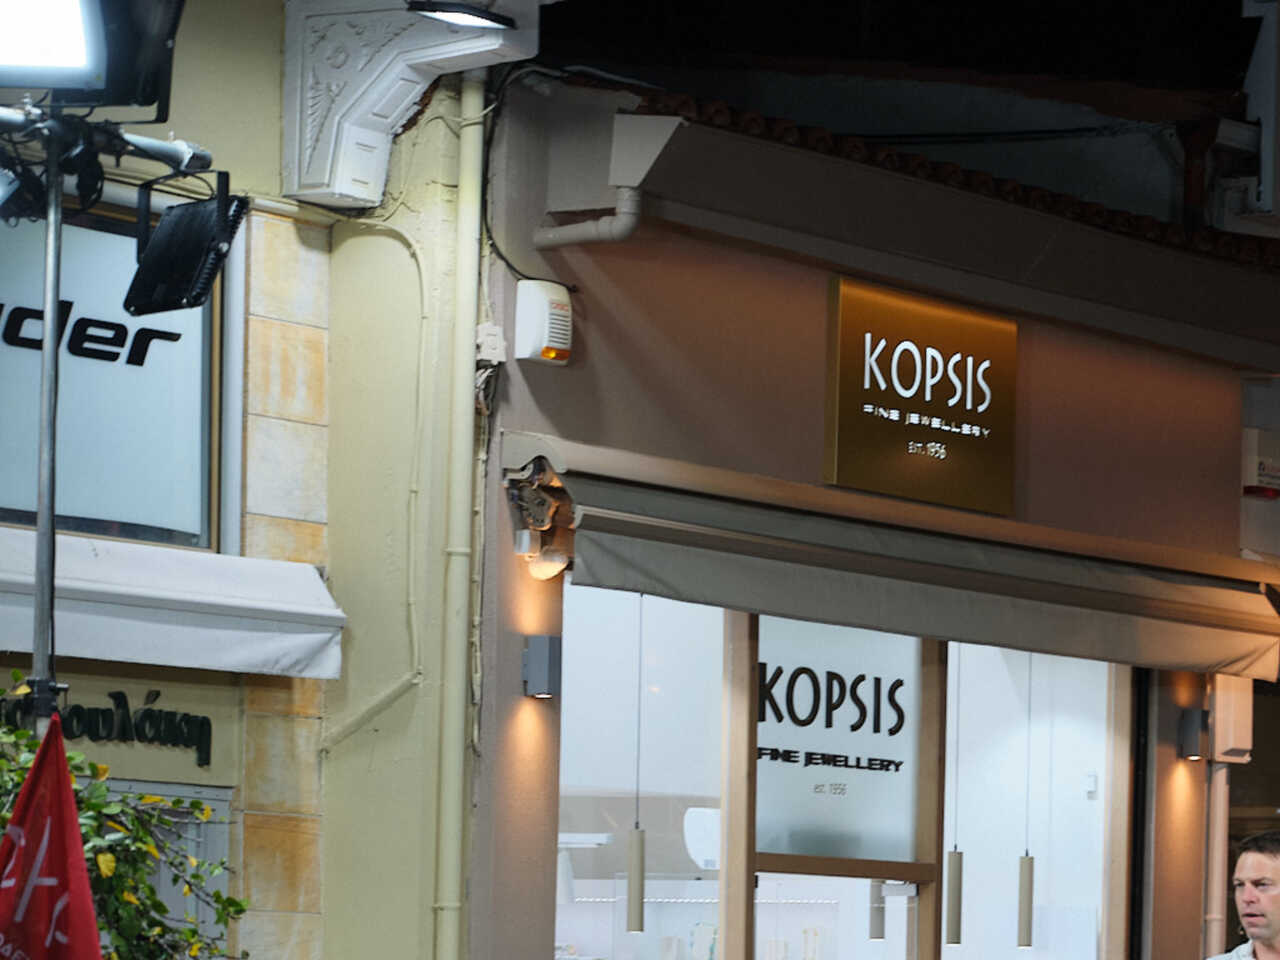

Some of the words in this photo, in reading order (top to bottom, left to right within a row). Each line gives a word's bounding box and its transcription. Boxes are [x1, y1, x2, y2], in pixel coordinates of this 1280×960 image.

[0, 300, 182, 367] der
[863, 332, 992, 414] KOPSIS
[863, 404, 900, 421] FINE
[904, 412, 991, 439] JEWELLERY
[757, 662, 905, 737] KOPSIS
[757, 747, 800, 764] FINE
[803, 751, 904, 773] JEWELLERY
